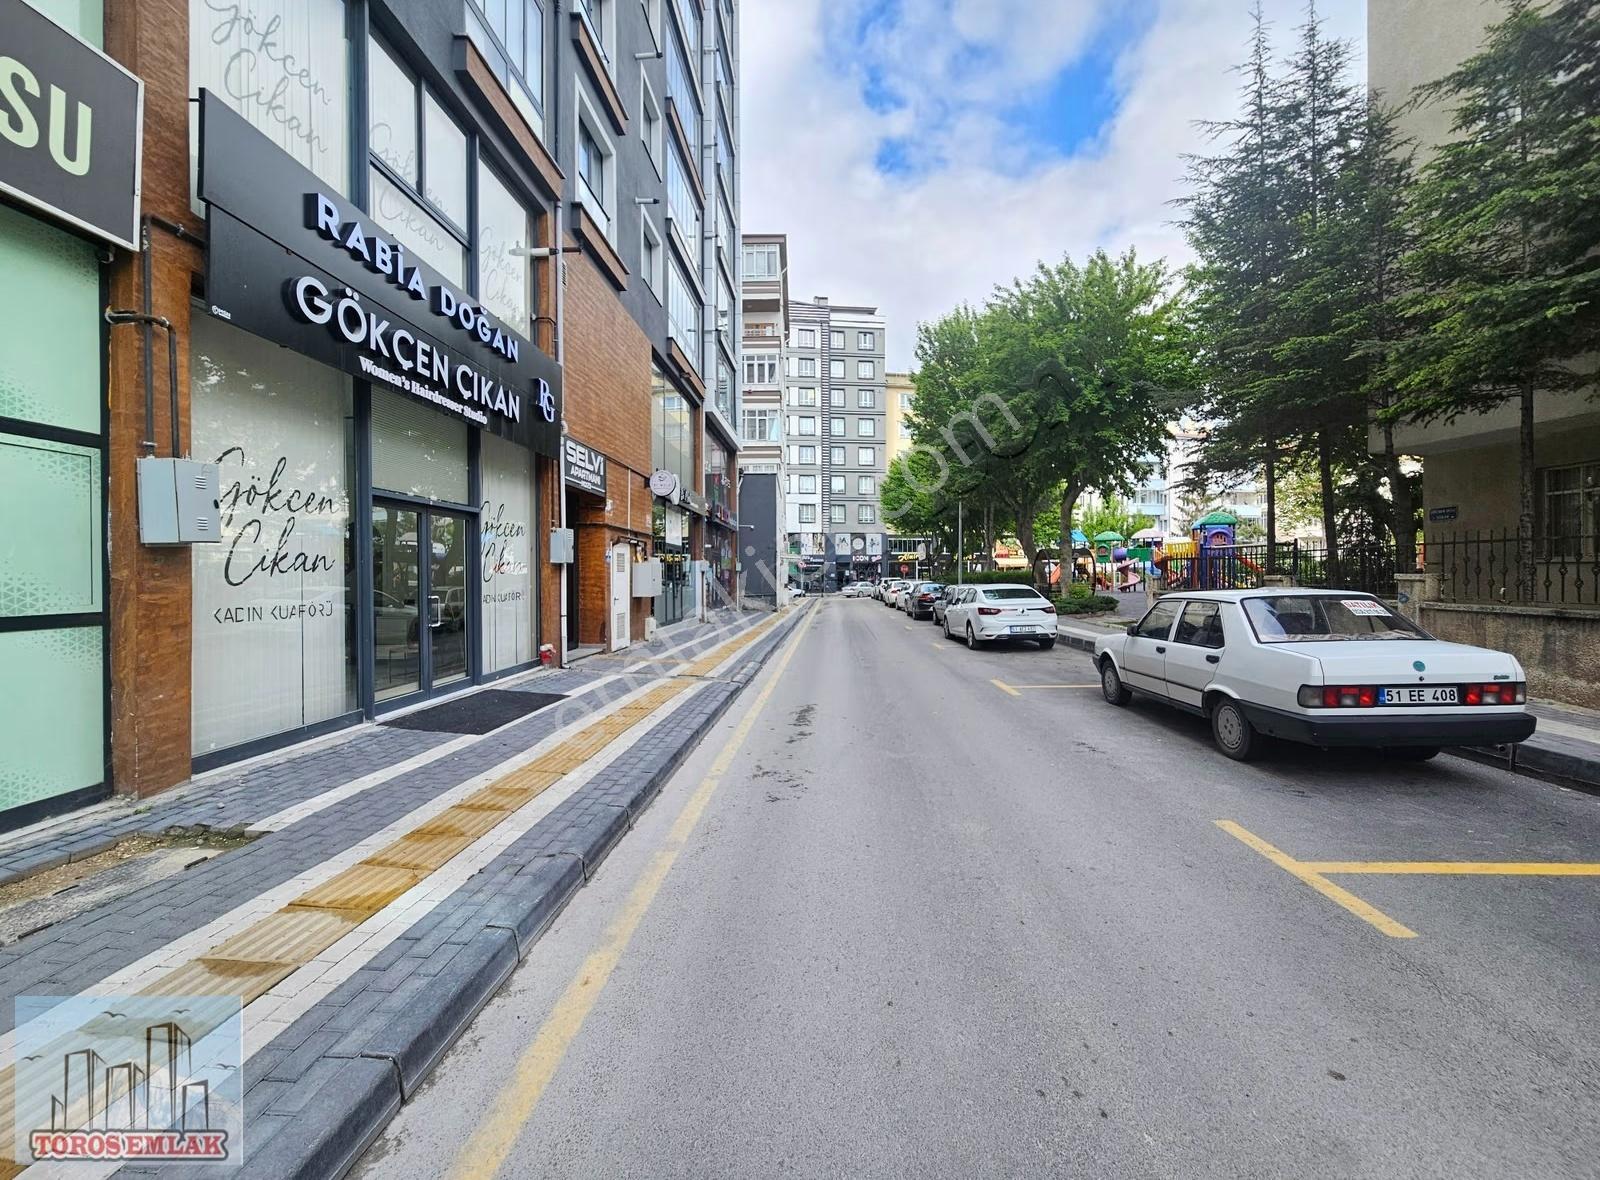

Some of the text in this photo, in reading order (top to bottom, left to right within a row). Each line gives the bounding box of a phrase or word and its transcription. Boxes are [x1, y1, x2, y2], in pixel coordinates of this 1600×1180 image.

[0, 56, 92, 176] SU
[318, 192, 519, 364] RABİA DOĞAN
[296, 276, 520, 423] GÖKÇEN ÇIKAN
[359, 355, 411, 390] Women's
[463, 405, 488, 425] Studio
[1386, 690, 1401, 702] 51
[1409, 689, 1425, 702] EE
[1432, 689, 1456, 702] 408
